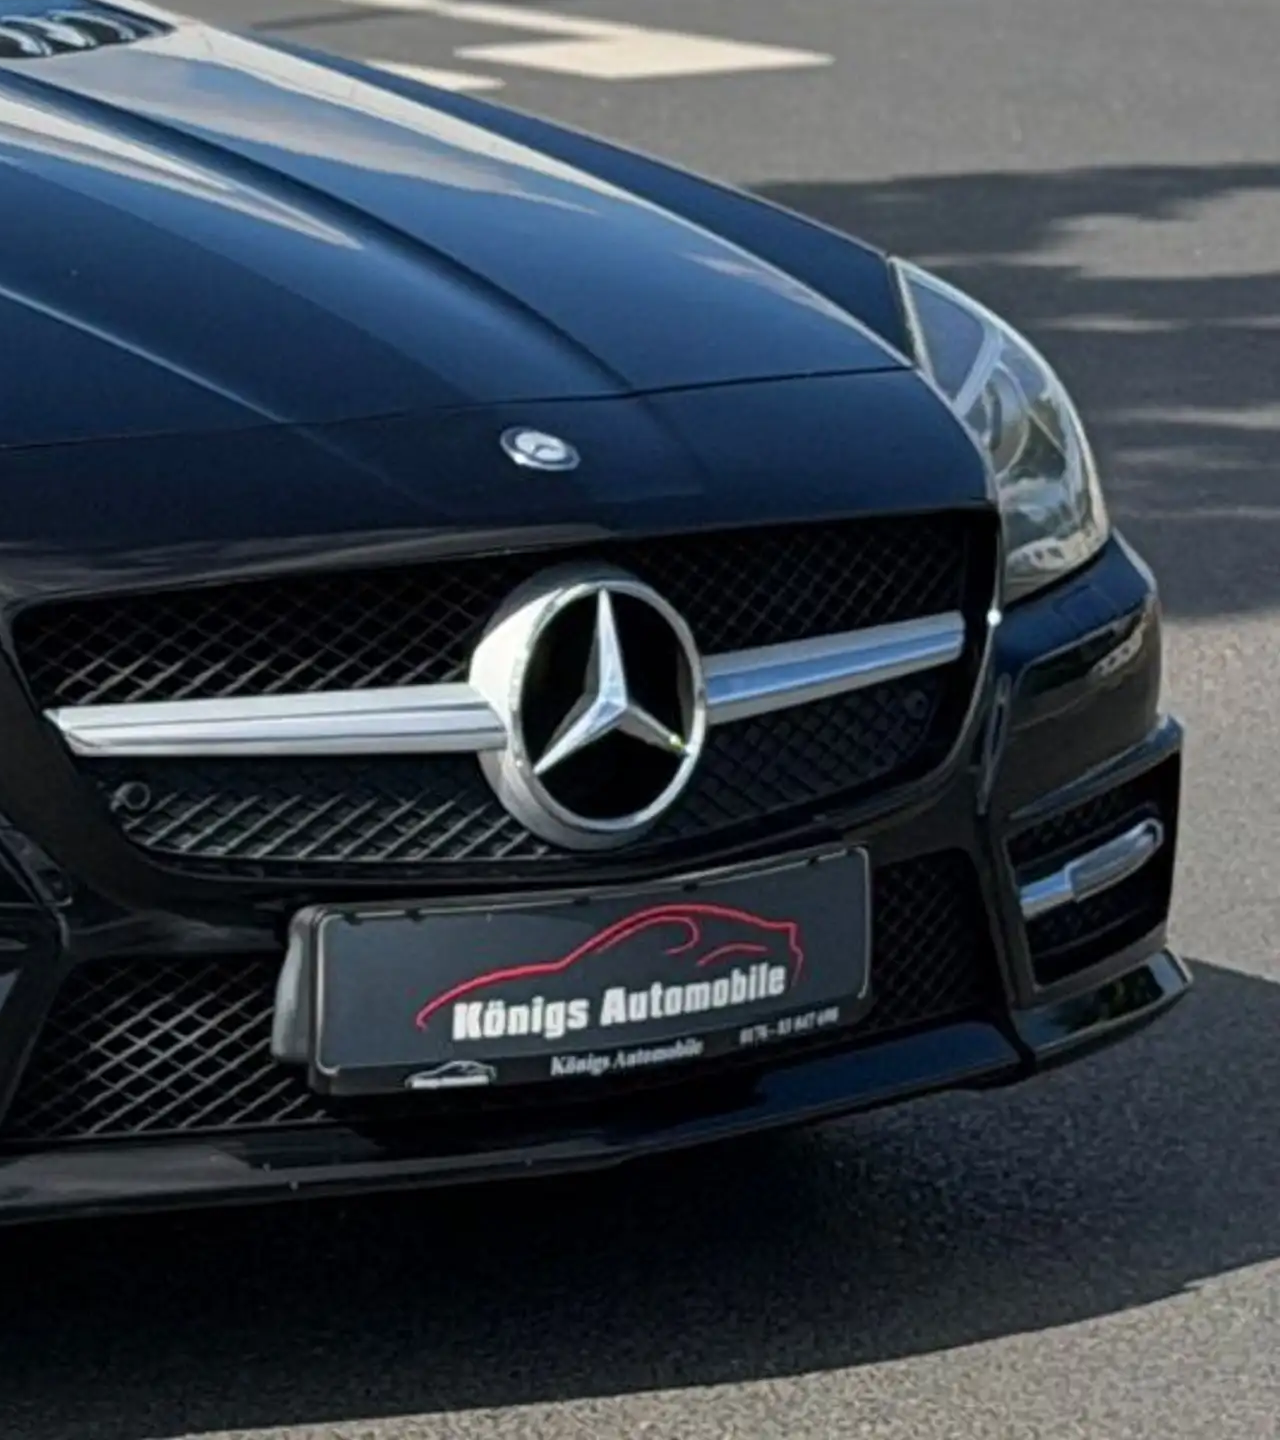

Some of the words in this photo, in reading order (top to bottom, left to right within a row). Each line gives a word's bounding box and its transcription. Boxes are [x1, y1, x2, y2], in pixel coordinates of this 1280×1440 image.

[452, 996, 589, 1041] Königs
[600, 963, 785, 1026] Automobile
[551, 1055, 611, 1077] Königs
[614, 1038, 704, 1068] Automobile
